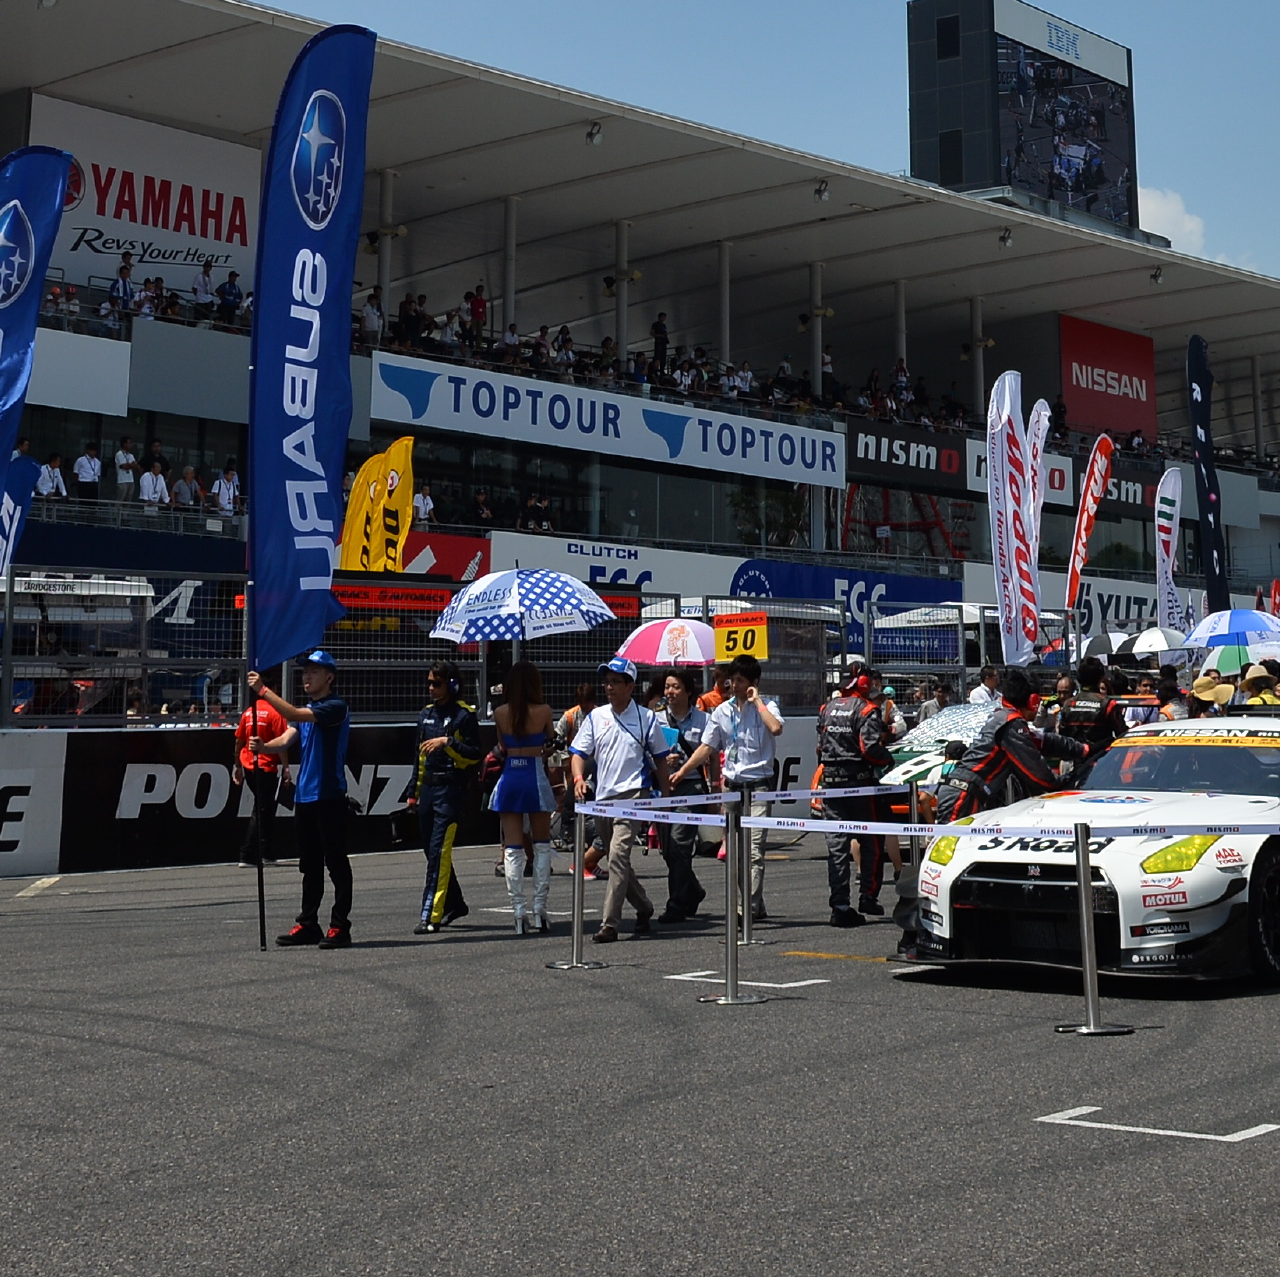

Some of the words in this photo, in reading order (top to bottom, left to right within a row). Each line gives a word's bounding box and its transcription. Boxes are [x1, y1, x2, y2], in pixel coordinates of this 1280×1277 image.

[1046, 21, 1081, 60] IBM
[91, 163, 248, 247] YAMAHA
[70, 227, 139, 253] Revs
[140, 241, 184, 263] Your
[183, 247, 233, 265] Heart
[1071, 361, 1147, 402] NISSAN
[448, 375, 621, 439] TOPTOUR
[697, 418, 837, 472] TOPTOUR
[857, 431, 960, 474] nismo
[567, 543, 639, 560] CLUTCH
[996, 510, 1007, 568] Honda
[466, 588, 513, 606] ENDLESS
[1001, 575, 1013, 636] Access
[724, 615, 765, 625] AUTOBACS
[725, 629, 756, 652] 50
[1158, 729, 1248, 737] NISSAN
[903, 825, 934, 833] nismo
[970, 826, 1003, 835] nismo
[1040, 828, 1073, 836] nismo
[1215, 848, 1242, 860] MAC
[1145, 894, 1186, 907] MOTUL
[1145, 923, 1189, 935] YOKOHAMA
